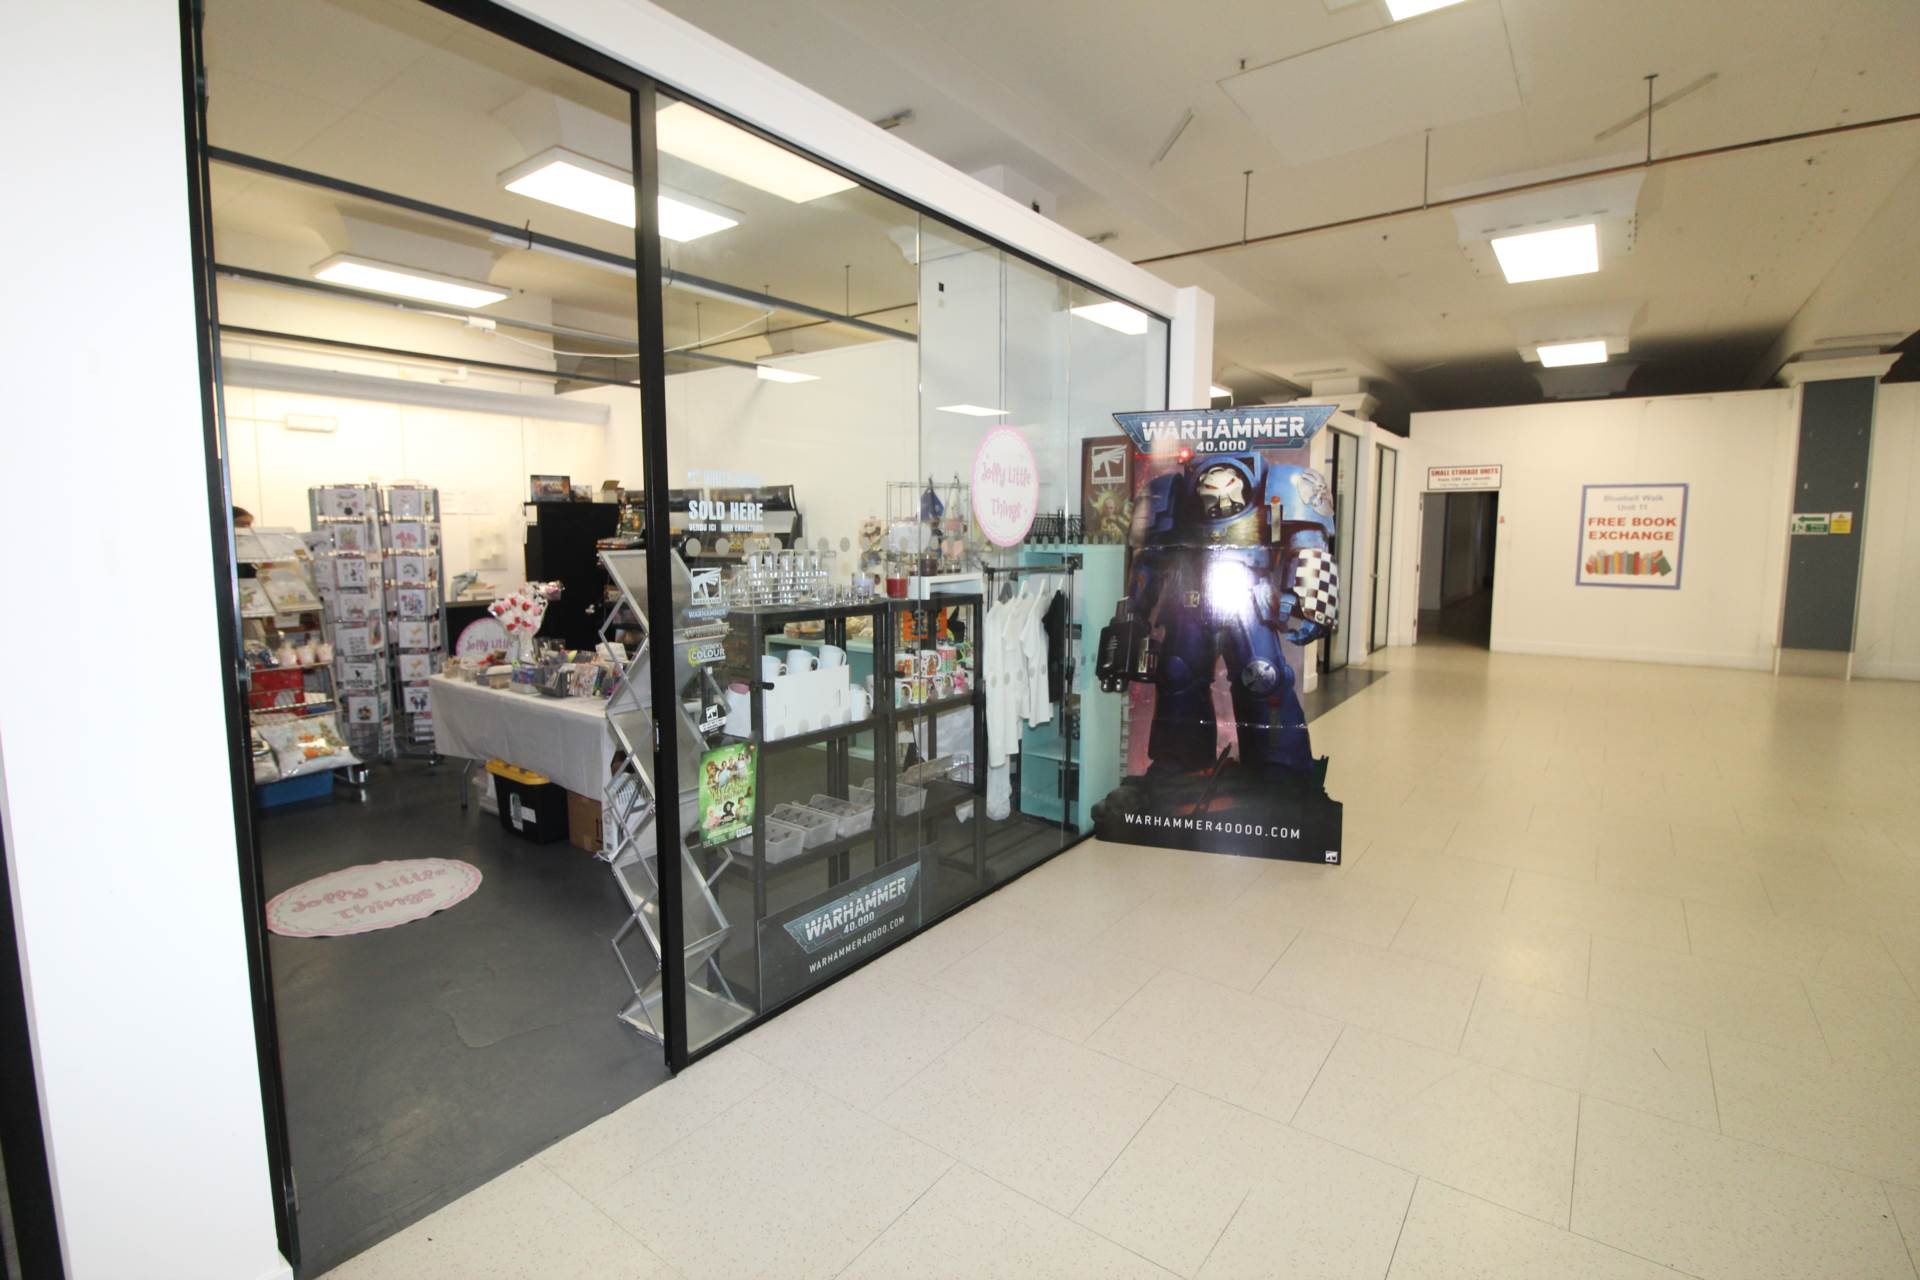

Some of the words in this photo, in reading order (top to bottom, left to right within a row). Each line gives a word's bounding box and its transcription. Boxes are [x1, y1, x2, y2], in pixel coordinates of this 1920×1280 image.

[1142, 416, 1305, 441] WARHAMMER
[1008, 465, 1031, 487] Little
[1431, 469, 1450, 477] SMALL
[1452, 468, 1479, 476] STORAGE
[1480, 467, 1499, 475] UNITS
[688, 500, 725, 521] SOLD
[730, 502, 763, 521] HERE
[991, 498, 1022, 523] Things
[1588, 517, 1626, 527] FREE
[1632, 517, 1677, 527] BOOK
[1588, 531, 1674, 541] EXCHANGE
[688, 607, 726, 619] WARHAMMER
[691, 648, 725, 660] COLOUR
[1124, 813, 1301, 840] WARHAMMER40000.COM
[804, 877, 907, 941] WARHAMMER
[808, 915, 905, 974] WARHAMMER40000.COM
